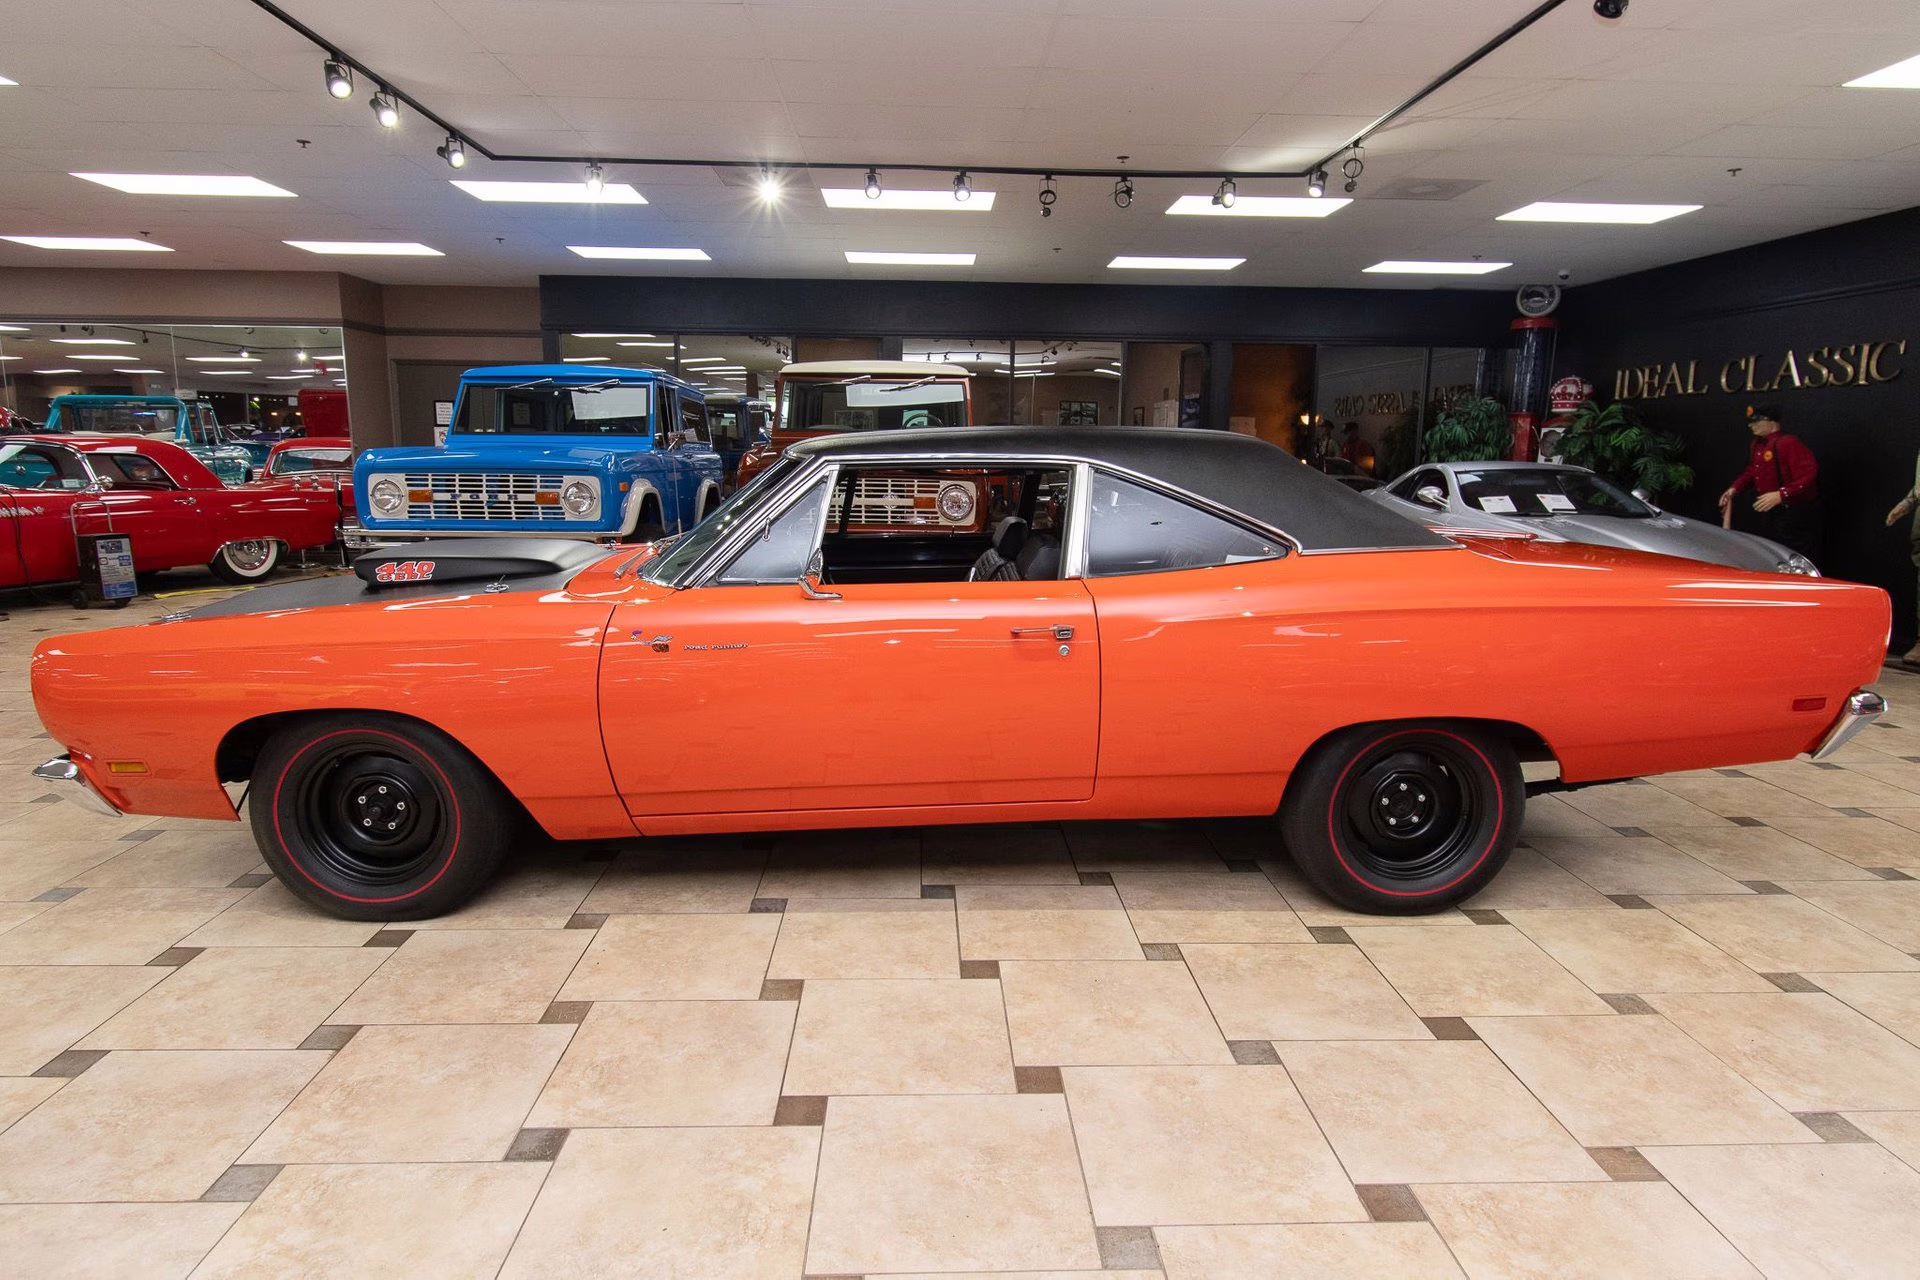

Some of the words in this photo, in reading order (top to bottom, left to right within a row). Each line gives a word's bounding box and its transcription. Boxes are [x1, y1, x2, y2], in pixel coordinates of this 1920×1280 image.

[1614, 359, 1709, 400] IDEAL
[1720, 339, 1906, 392] CLASSIC
[375, 561, 435, 574] 440
